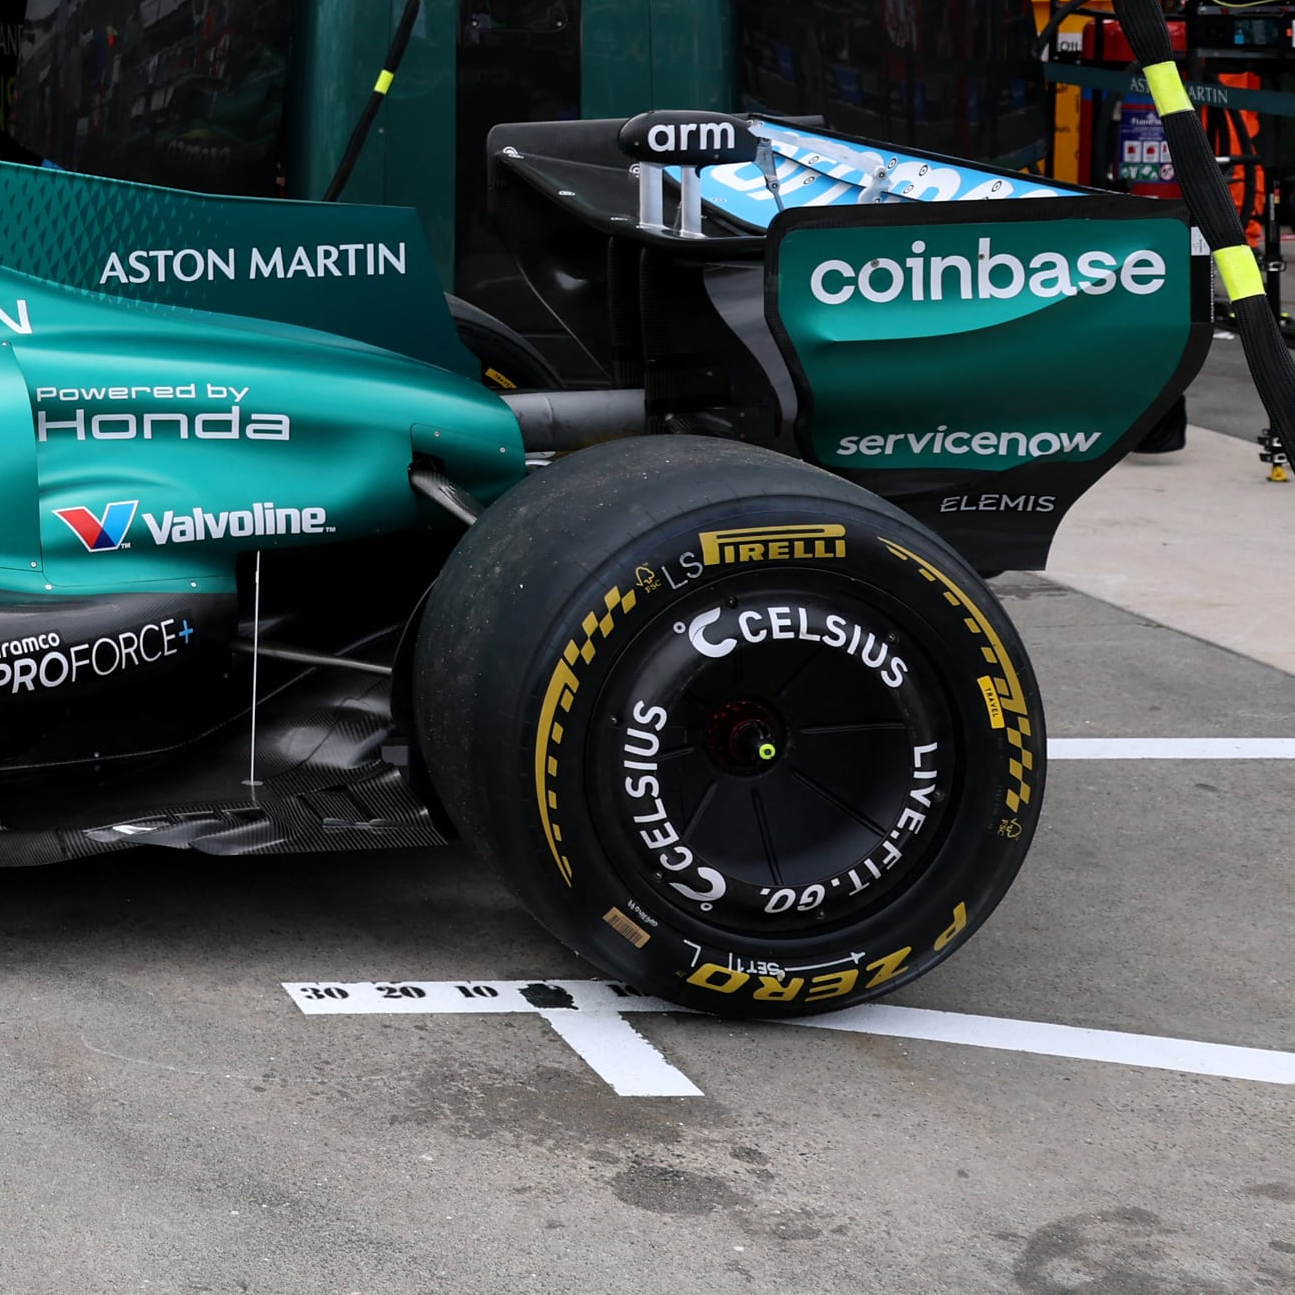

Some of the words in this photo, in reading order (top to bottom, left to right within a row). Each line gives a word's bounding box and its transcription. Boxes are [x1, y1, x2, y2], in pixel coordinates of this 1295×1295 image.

[647, 120, 736, 153] arm
[99, 248, 240, 286] ASTON
[247, 241, 406, 280] MARTIN
[810, 238, 1167, 305] coinbase
[36, 383, 197, 403] Powered
[206, 383, 250, 403] by
[37, 405, 291, 443] Honda
[836, 424, 1103, 458] servicenow
[142, 502, 327, 545] Valvoline
[939, 493, 1056, 514] ELEMIS
[699, 524, 847, 566] PIRELLI
[737, 606, 909, 689] CELSIUS
[623, 699, 694, 872] CELSIUS
[933, 901, 968, 953] P
[300, 986, 350, 1000] 30
[377, 985, 427, 999] 20
[454, 984, 500, 999] 10
[686, 945, 913, 1002] ZERO
